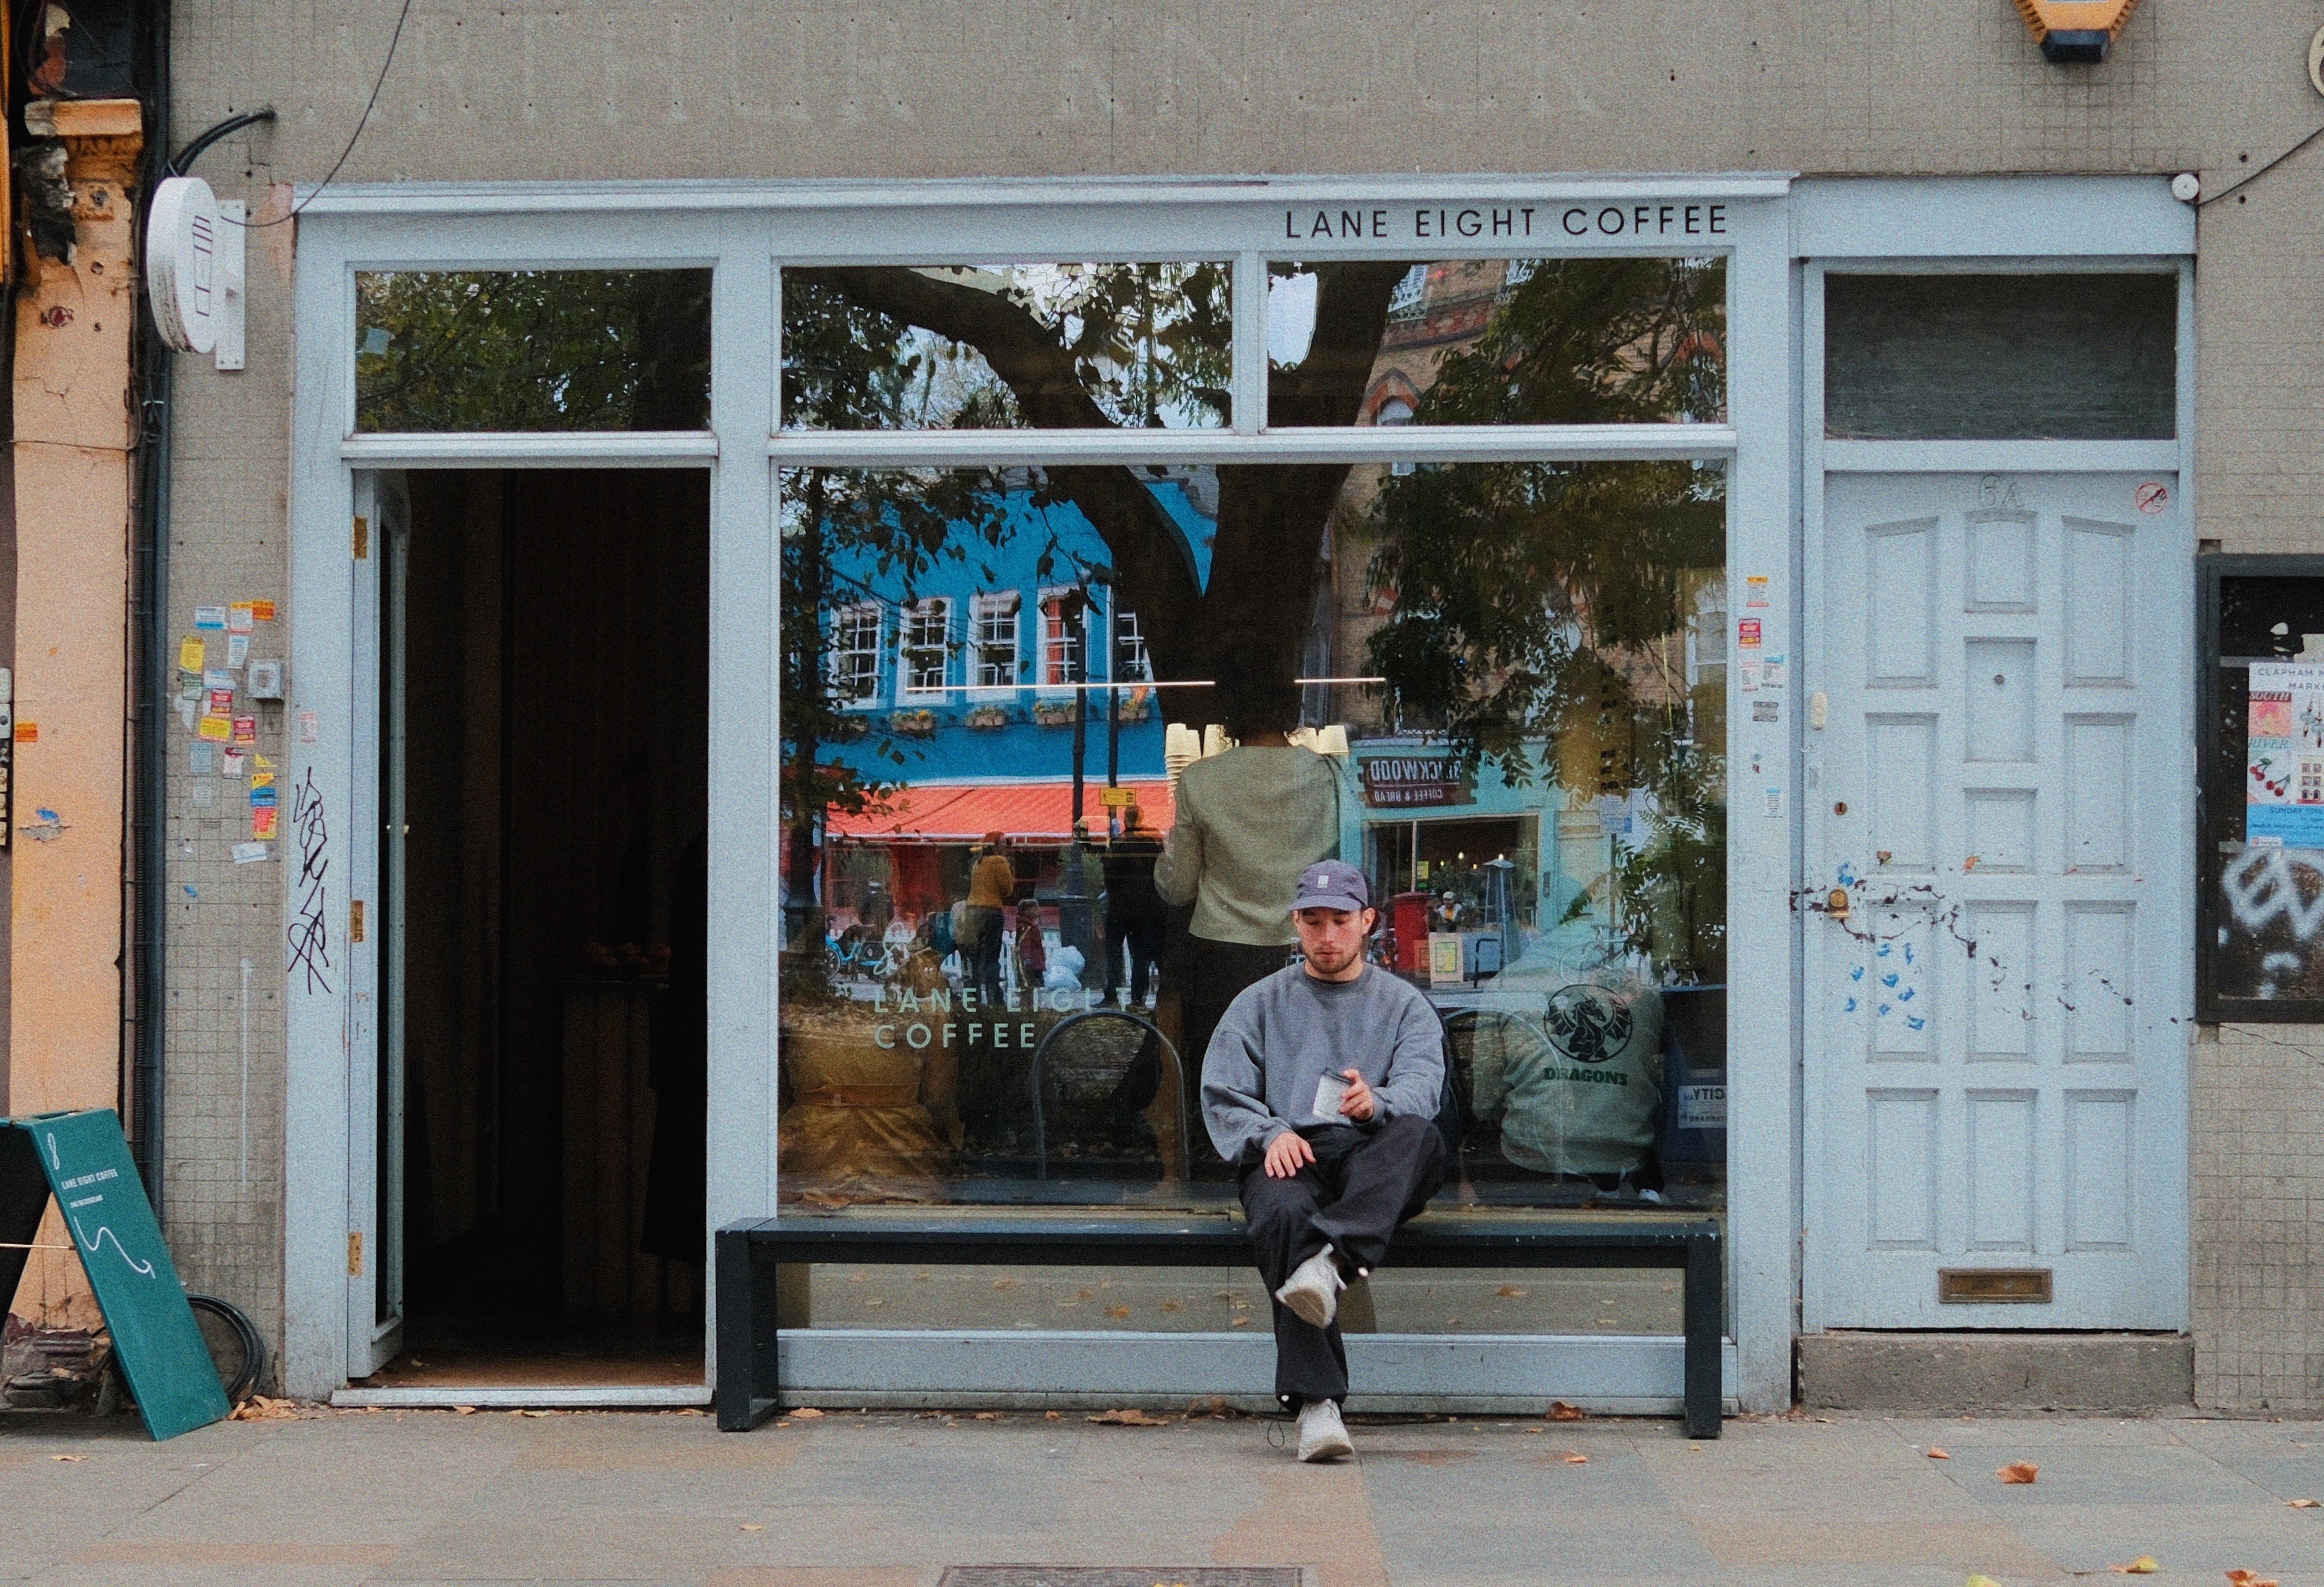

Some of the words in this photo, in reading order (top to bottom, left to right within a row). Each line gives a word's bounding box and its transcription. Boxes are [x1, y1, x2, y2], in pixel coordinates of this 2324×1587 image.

[1287, 210, 1387, 238] LANE
[1418, 208, 1534, 237] EIGHT
[1563, 205, 1726, 235] COFFEE
[1978, 474, 2025, 508] 6A
[2258, 668, 2313, 677] CLAPHAM
[2250, 692, 2289, 701] SOUTH
[2249, 738, 2289, 749] RIVER
[874, 988, 977, 1013] LANE
[874, 1023, 1035, 1049] COFFEE
[61, 1178, 78, 1190] LANE
[77, 1174, 95, 1186] EIGHT
[95, 1168, 119, 1182] COFFEE
